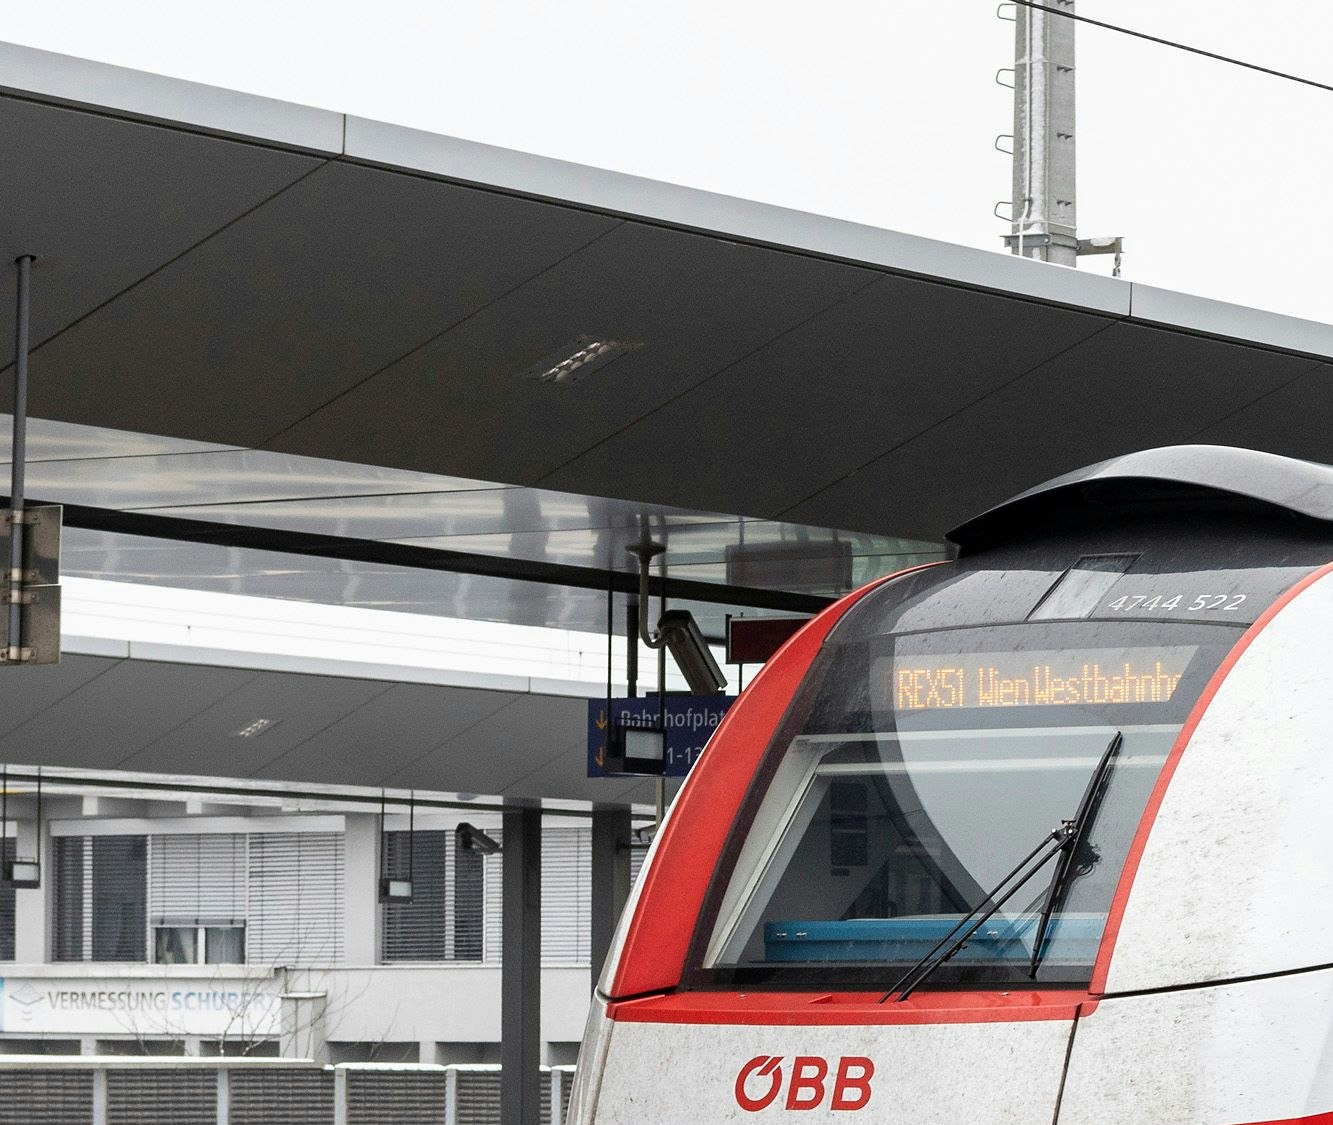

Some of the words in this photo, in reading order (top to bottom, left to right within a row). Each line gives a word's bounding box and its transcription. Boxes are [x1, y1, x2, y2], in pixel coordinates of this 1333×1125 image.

[1108, 594, 1183, 611] 4744
[1187, 594, 1247, 611] 522
[898, 668, 964, 708] REX51
[977, 667, 1029, 707] Wien
[48, 991, 167, 1011] VERMESSUNG
[735, 1055, 875, 1112] ÖBB
